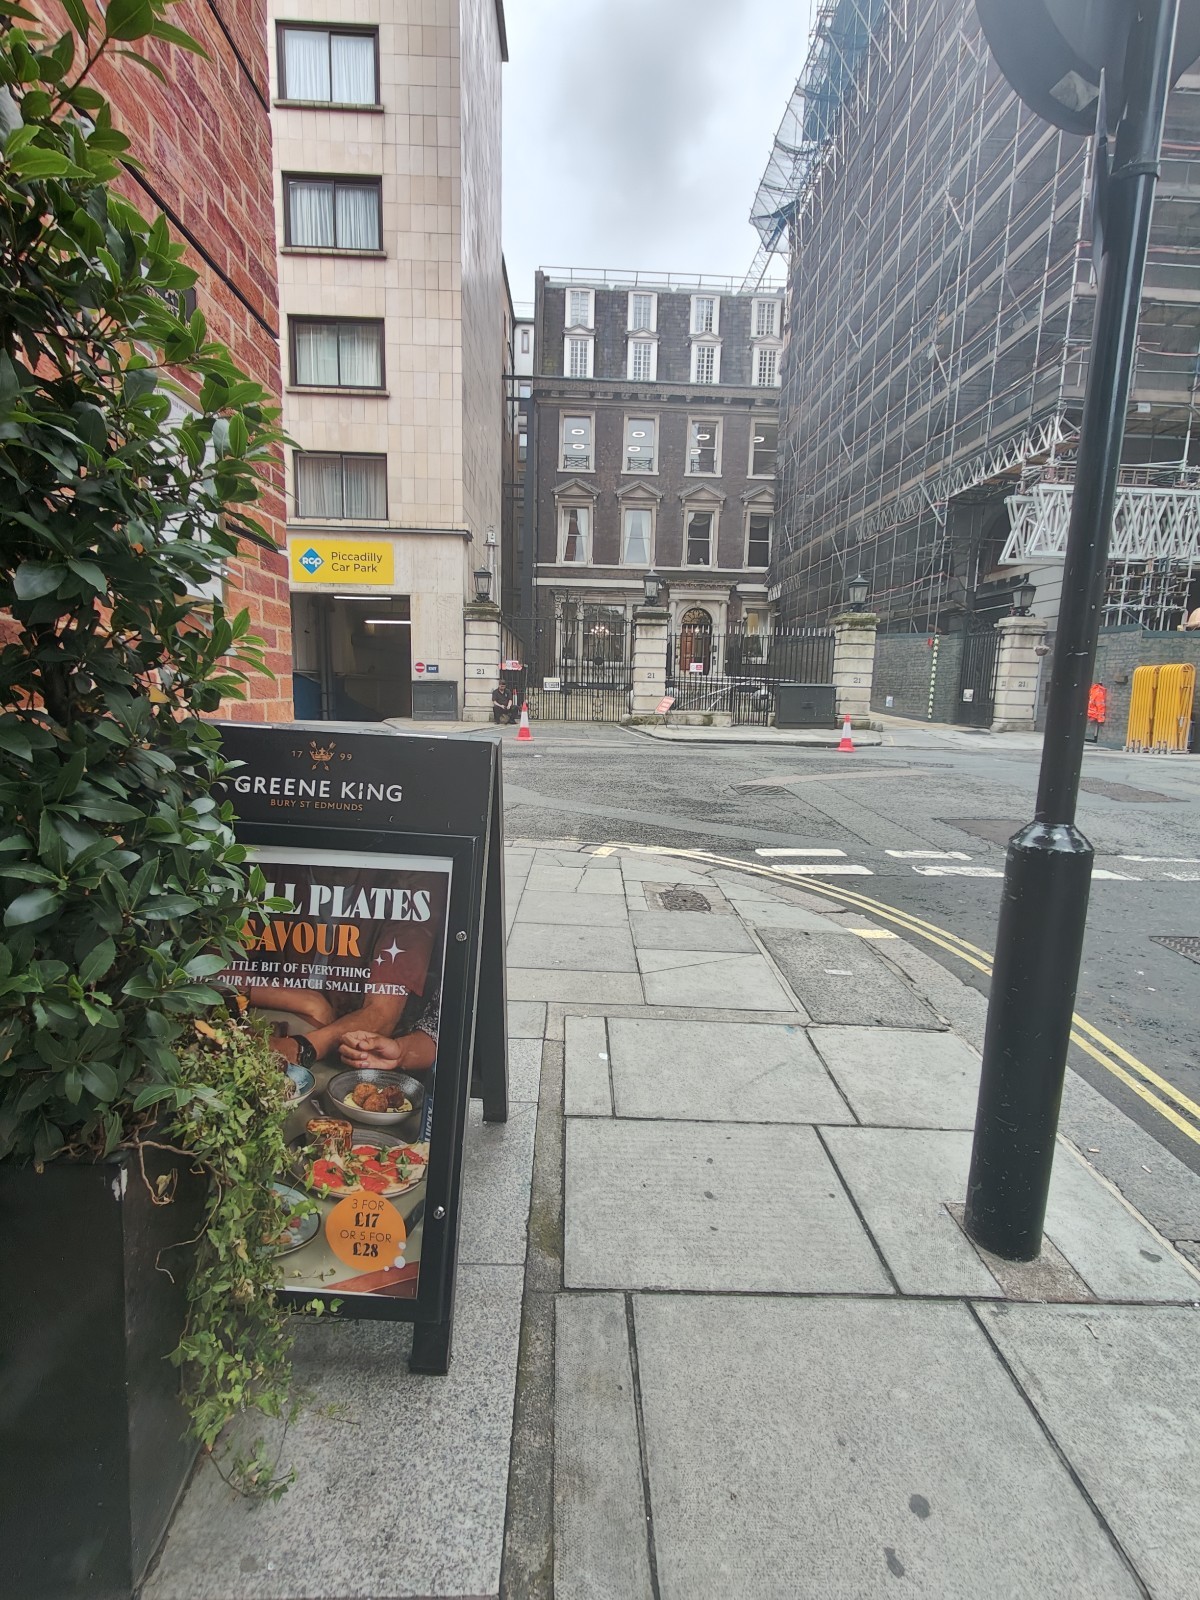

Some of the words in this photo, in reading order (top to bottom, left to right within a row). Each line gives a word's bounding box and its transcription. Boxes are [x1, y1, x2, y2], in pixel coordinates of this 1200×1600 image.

[331, 551, 383, 563] Piccadilly
[331, 562, 350, 572] Car
[353, 563, 378, 573] Park
[291, 750, 303, 758] 17
[339, 752, 353, 761] 99
[234, 775, 331, 798] GREENE
[340, 781, 403, 803] KING
[270, 798, 296, 807] BURY
[314, 801, 364, 811] EDMUNDS
[308, 884, 431, 922] PLATES
[238, 919, 361, 958] SAVOUR
[222, 960, 259, 972] TTLE
[261, 961, 281, 973] BIT
[283, 962, 300, 974] OF
[301, 964, 371, 979] EVERYTHING
[244, 976, 269, 987] MIX
[271, 977, 280, 988] &
[283, 977, 323, 990] MATCH
[325, 980, 361, 993] SMALL
[364, 983, 409, 996] PLATES.
[352, 1198, 358, 1209] 3
[361, 1199, 385, 1211] FOR
[355, 1212, 380, 1228] £17
[340, 1229, 356, 1239] OR
[360, 1231, 366, 1241] 5
[370, 1232, 392, 1243] FOR
[353, 1242, 379, 1258] £28
